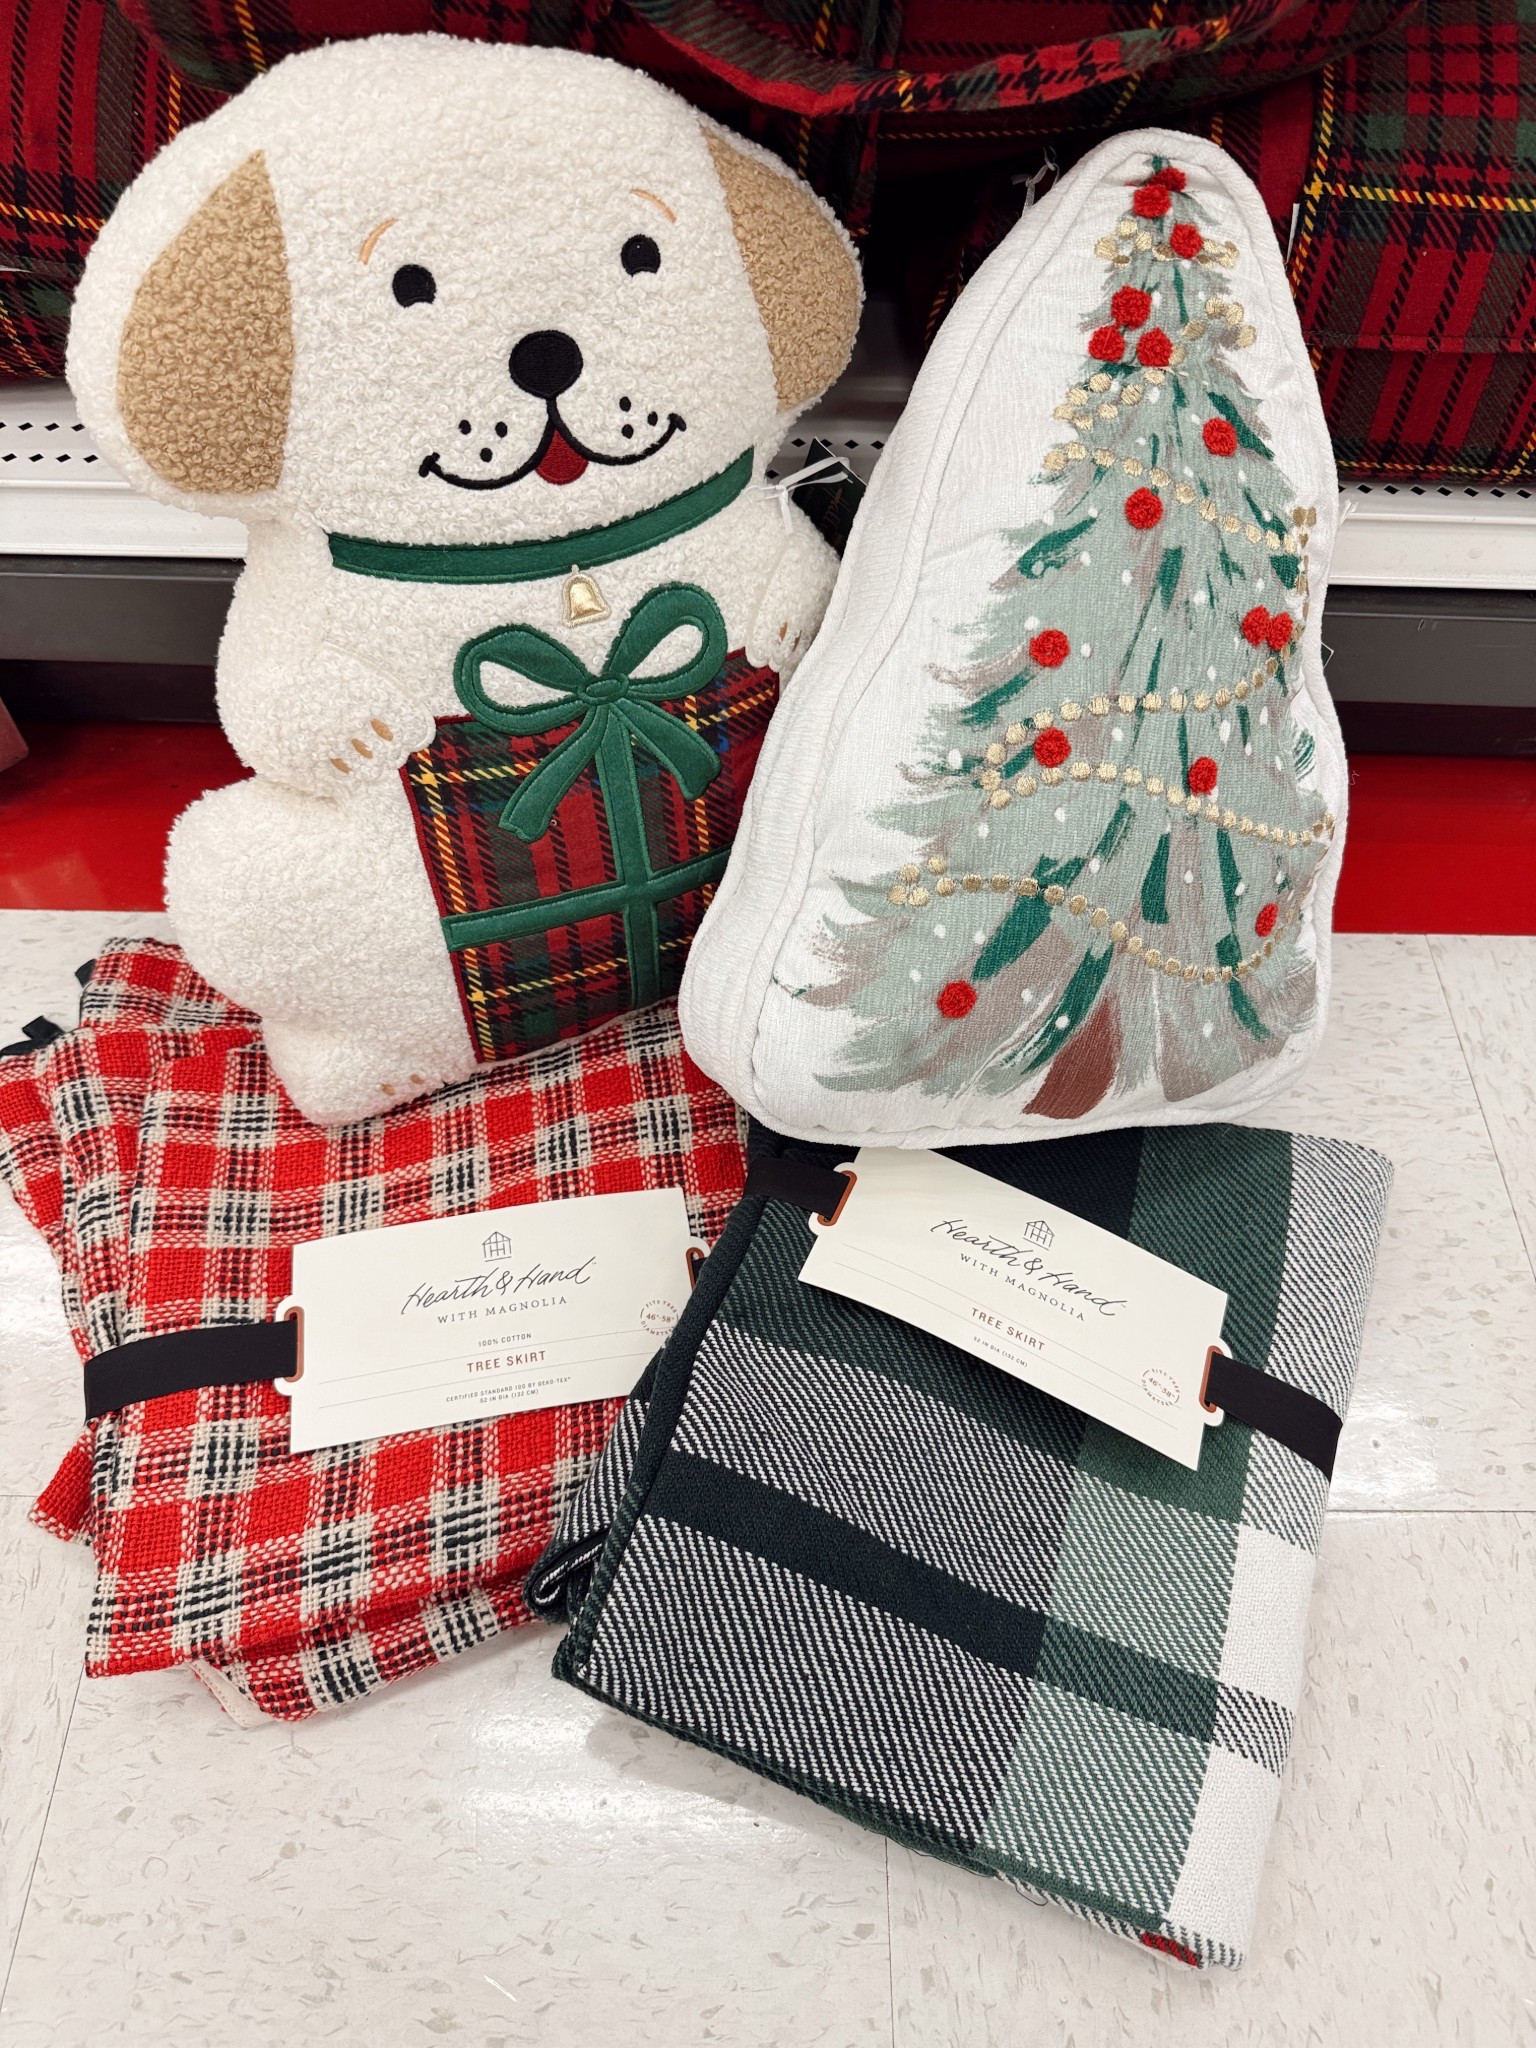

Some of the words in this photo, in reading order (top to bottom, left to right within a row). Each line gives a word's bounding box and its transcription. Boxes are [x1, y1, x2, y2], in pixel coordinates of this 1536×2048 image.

[931, 1220, 1034, 1267] Hearth
[1024, 1258, 1043, 1275] &
[401, 1267, 499, 1315] Hearth
[495, 1271, 513, 1296] &
[960, 1253, 999, 1277] WITH
[1005, 1276, 1085, 1321] MAGNOLIA
[437, 1310, 478, 1324] WITH
[485, 1296, 567, 1317] MAGNOLIA
[478, 1338, 499, 1347] 100%
[501, 1333, 532, 1344] COTTON
[971, 1307, 1003, 1330] TREE
[1006, 1326, 1045, 1351] SKIRT
[467, 1358, 501, 1373] TREE
[506, 1350, 546, 1366] SKIRT
[1002, 1350, 1015, 1360] (132
[1016, 1358, 1028, 1367] CM)
[446, 1391, 479, 1402] CERTIFIED
[480, 1386, 513, 1396] STANDARD
[511, 1391, 525, 1400] (132
[526, 1388, 539, 1396] CM)
